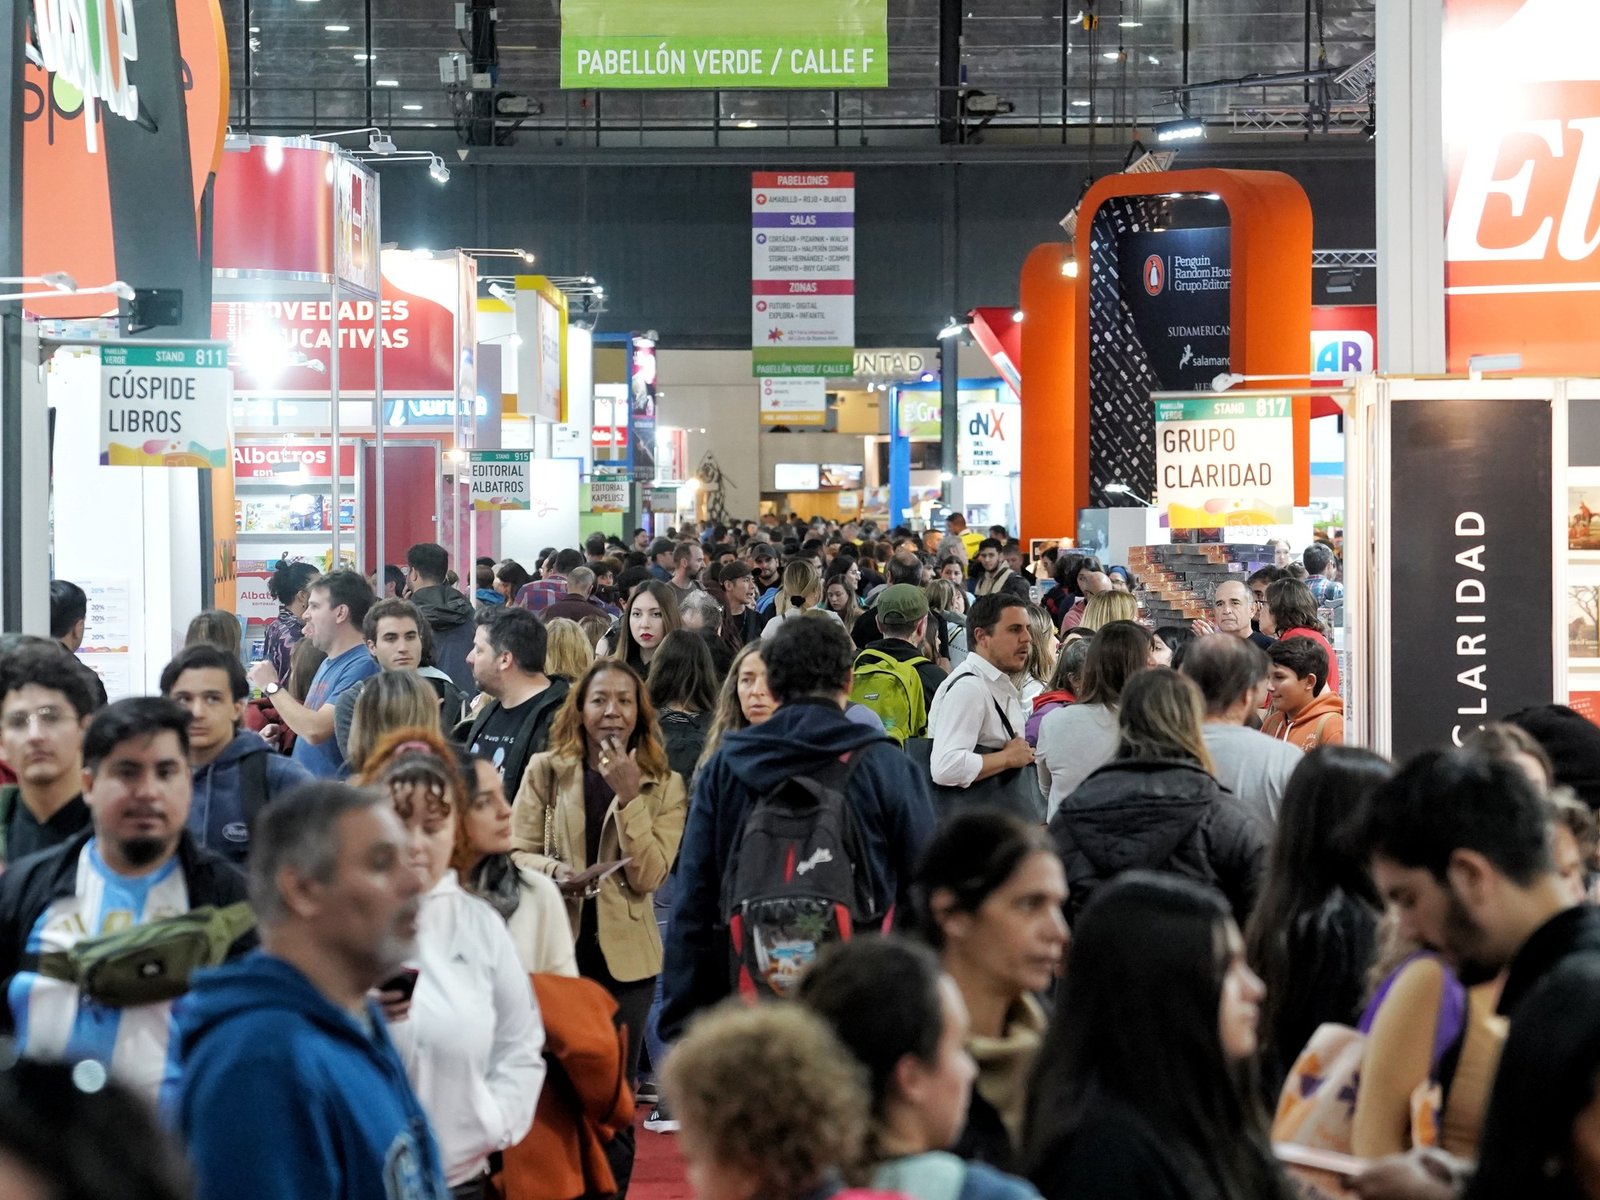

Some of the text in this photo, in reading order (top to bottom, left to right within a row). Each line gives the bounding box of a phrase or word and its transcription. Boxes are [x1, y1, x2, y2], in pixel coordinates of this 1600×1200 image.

[578, 42, 686, 74] PABELLÓN
[693, 49, 762, 74] VERDE
[790, 49, 855, 74] CALLE
[862, 48, 874, 73] F
[777, 175, 829, 185] PABELLONES
[790, 215, 816, 225] SALAS
[1175, 255, 1210, 270] Penguin
[1175, 266, 1231, 279] Random Hous
[789, 282, 817, 293] ZONAS
[1174, 280, 1202, 293] Grupo
[248, 300, 409, 321] OVEDADES
[1168, 325, 1231, 337] SUDAMERICAN
[260, 328, 409, 348] UCATIVAS
[156, 351, 185, 362] STAND
[195, 349, 223, 365] 811
[1312, 341, 1362, 372] AR
[756, 363, 791, 374] PABELLÓN
[793, 365, 814, 373] VERDE
[822, 365, 844, 373] CALLE
[109, 369, 196, 400] CÚSPIDE
[1214, 402, 1245, 415] STAND
[1256, 398, 1287, 417] 817
[109, 409, 182, 433] LIBROS
[1163, 428, 1235, 453] GRUPO
[233, 448, 327, 464] Albatros
[514, 452, 529, 461] 915
[472, 465, 524, 477] EDITORIAL
[1164, 463, 1272, 489] CLARIDAD
[472, 481, 524, 493] ALBATROS
[591, 483, 624, 492] EDITORIAL
[592, 493, 624, 502] KAPELUSZ
[240, 591, 273, 600] Albat
